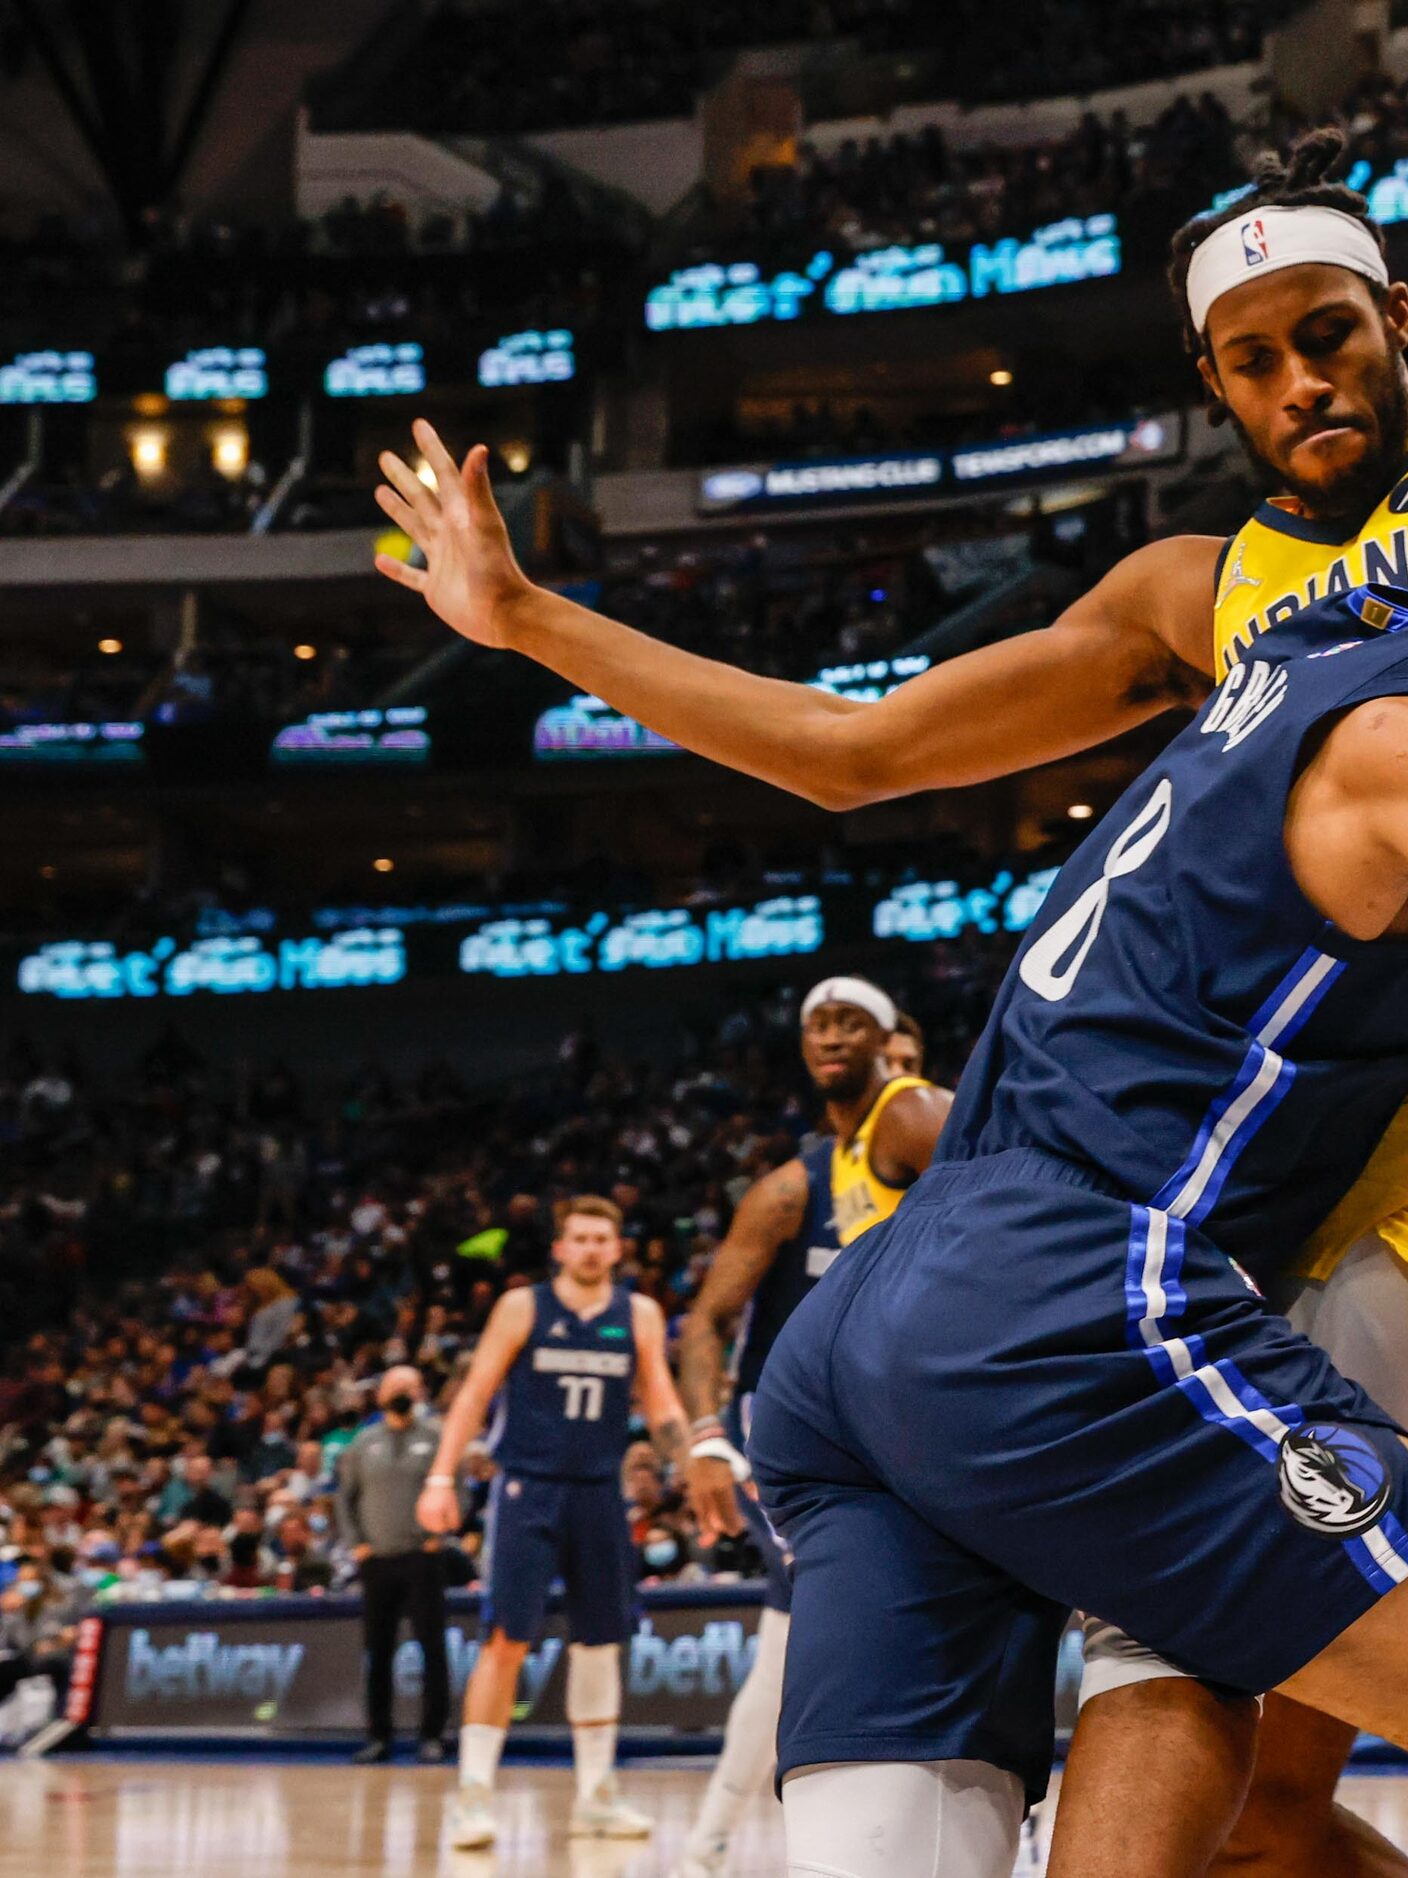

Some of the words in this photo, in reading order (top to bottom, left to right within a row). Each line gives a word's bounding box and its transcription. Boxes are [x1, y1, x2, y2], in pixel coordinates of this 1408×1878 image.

[1019, 777, 1173, 1002] 8
[556, 1374, 605, 1422] 77
[126, 1628, 304, 1720] betway
